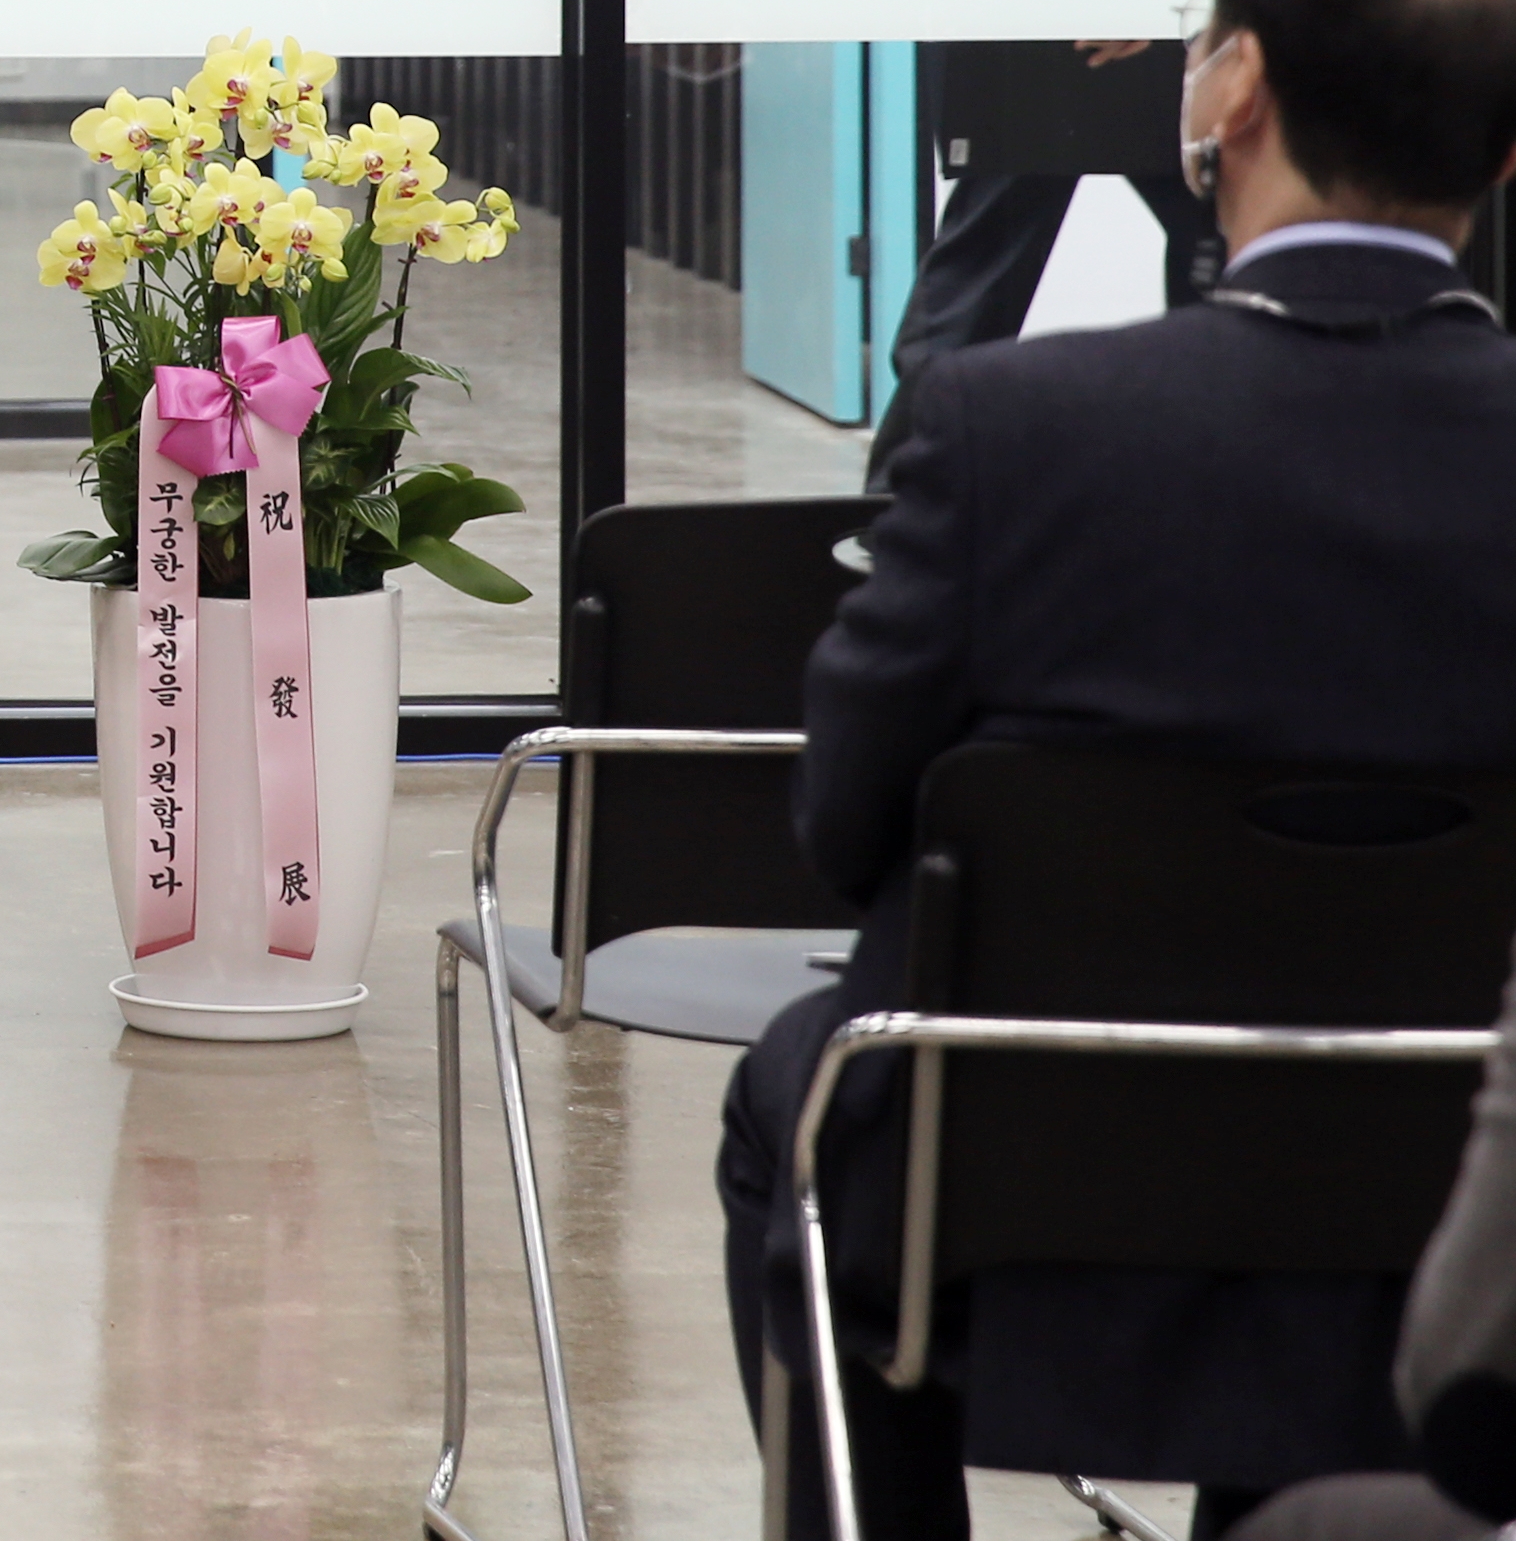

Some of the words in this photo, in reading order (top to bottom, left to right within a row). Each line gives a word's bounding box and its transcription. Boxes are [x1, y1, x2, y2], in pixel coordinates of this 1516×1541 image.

[148, 480, 185, 583] 무궁한
[147, 602, 185, 707] 발전을
[147, 724, 184, 898] 기원합니다
